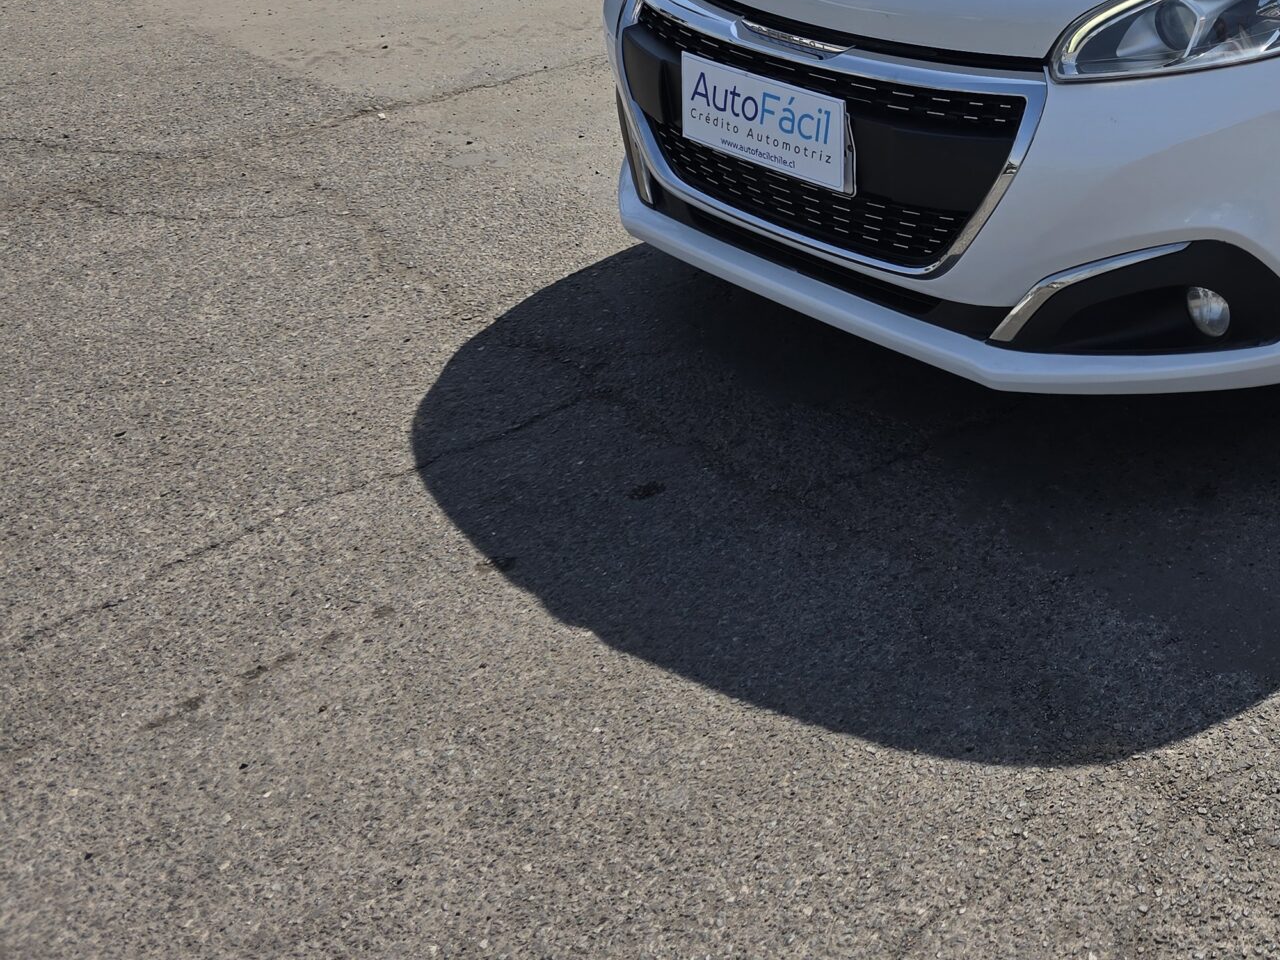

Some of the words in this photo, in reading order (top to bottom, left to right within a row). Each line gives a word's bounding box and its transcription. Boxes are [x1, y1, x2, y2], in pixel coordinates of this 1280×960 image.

[690, 71, 831, 145] AutoFácil
[690, 107, 739, 134] Crédito
[746, 128, 832, 164] Automotriz
[720, 137, 796, 169] www.autofacilchile.cl
